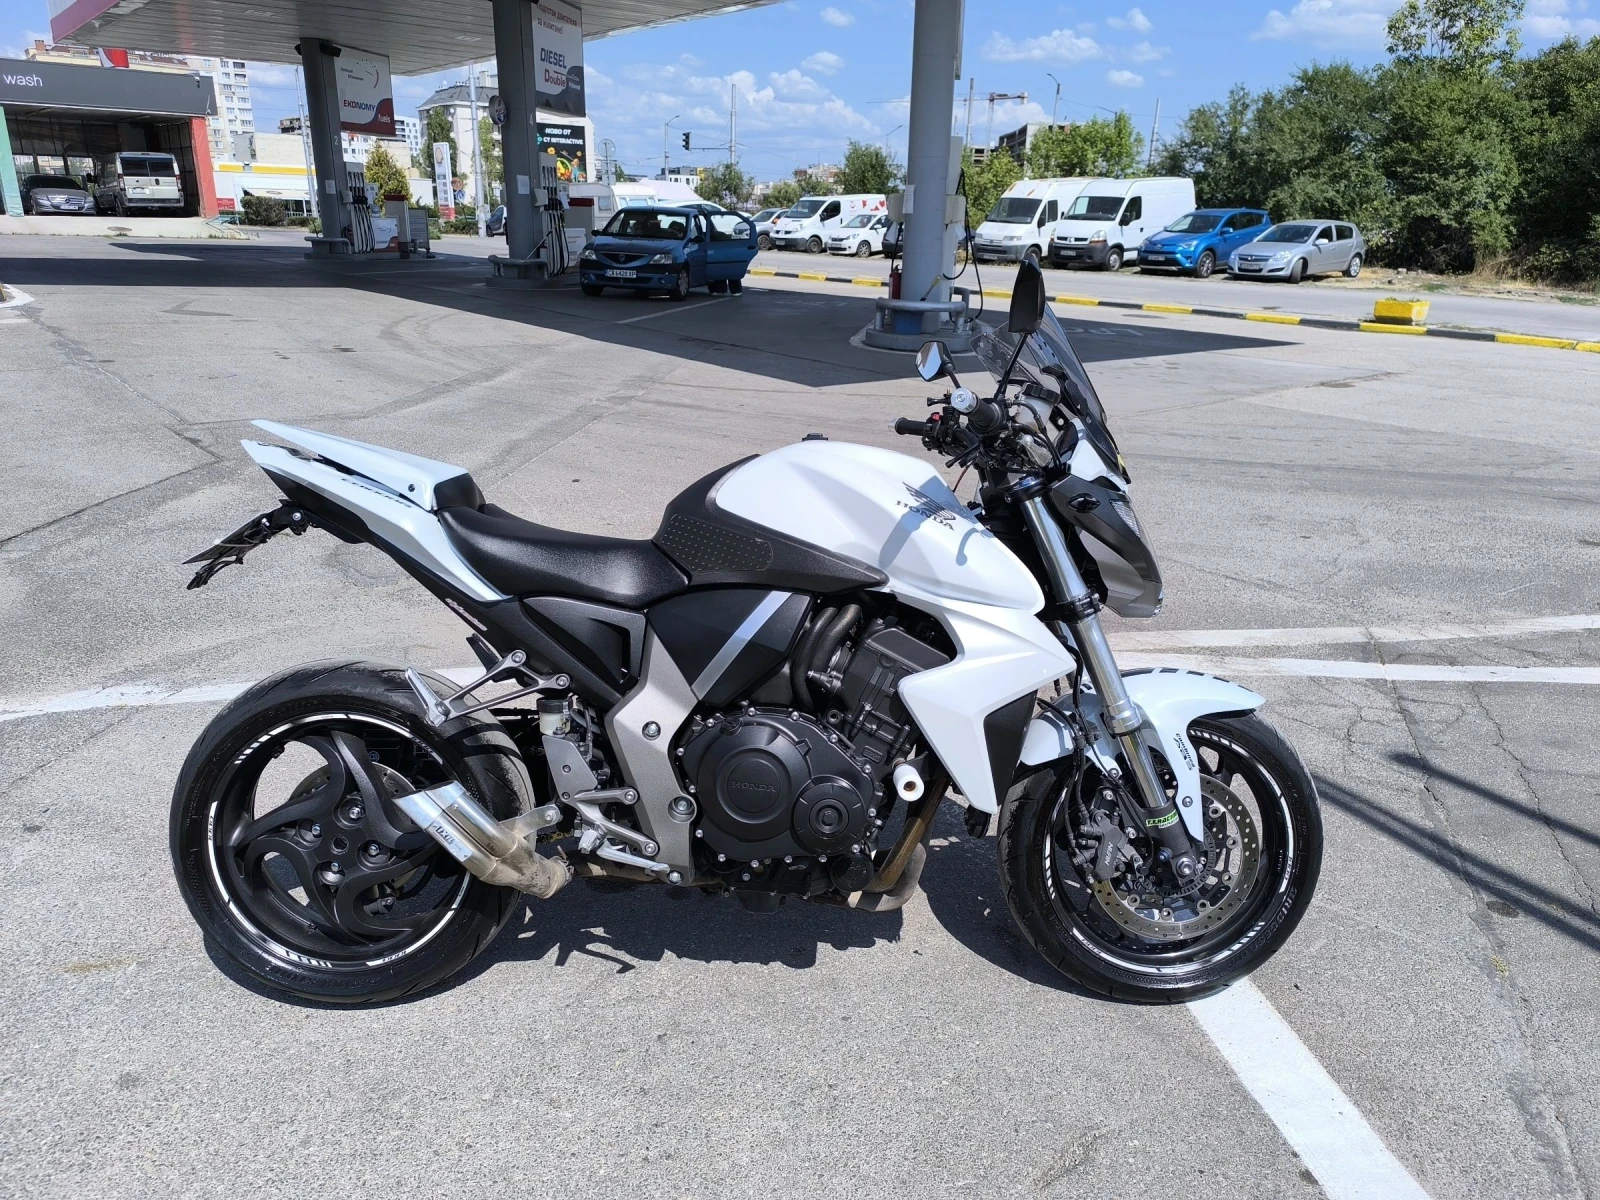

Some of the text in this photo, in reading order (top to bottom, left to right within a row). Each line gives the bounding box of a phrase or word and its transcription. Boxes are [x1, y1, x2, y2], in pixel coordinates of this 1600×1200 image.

[540, 47, 566, 69] DIESEL
[3, 73, 43, 87] wash
[544, 68, 566, 87] Double
[343, 99, 376, 112] EKONOMY
[334, 136, 339, 145] 2
[551, 136, 583, 145] INTERACTIVE
[895, 500, 955, 531] HONDA
[731, 780, 776, 793] HONDA
